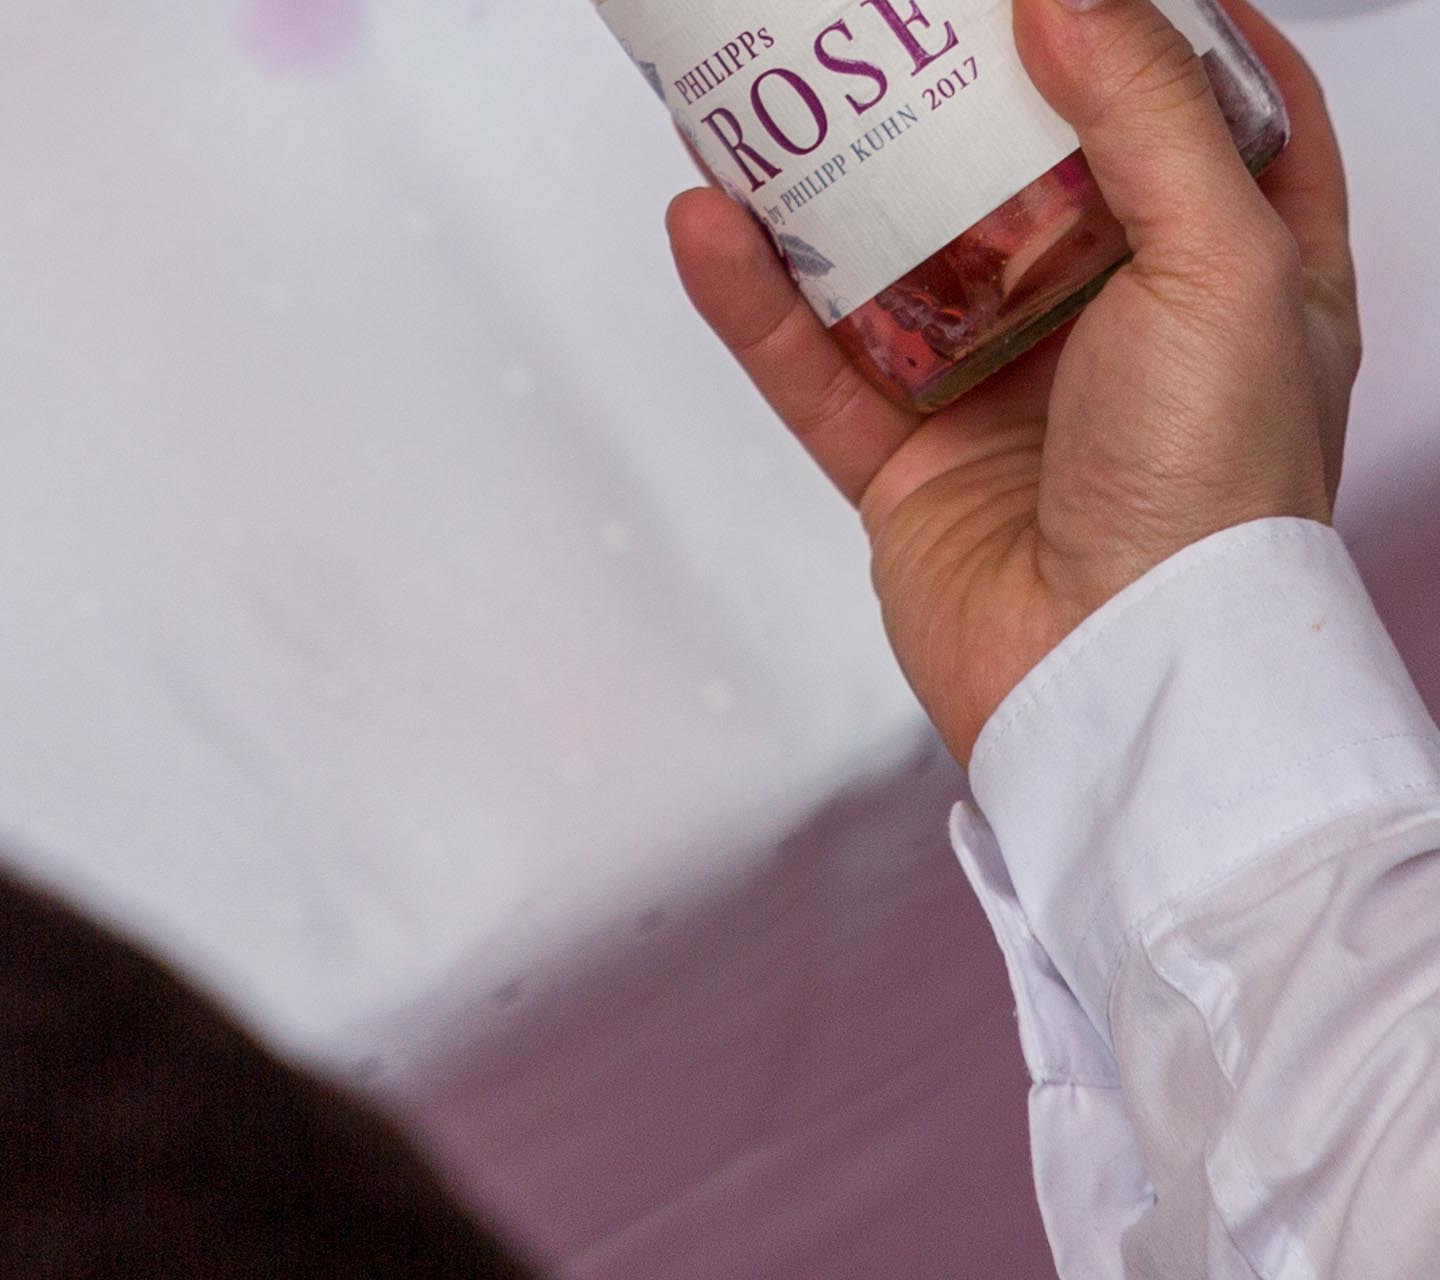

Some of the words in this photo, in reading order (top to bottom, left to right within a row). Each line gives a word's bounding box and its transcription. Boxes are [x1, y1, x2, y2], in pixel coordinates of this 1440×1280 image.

[764, 206, 786, 226] by
[780, 154, 847, 214] PHILIPP
[850, 104, 918, 163] KUHN
[921, 56, 979, 111] 2017
